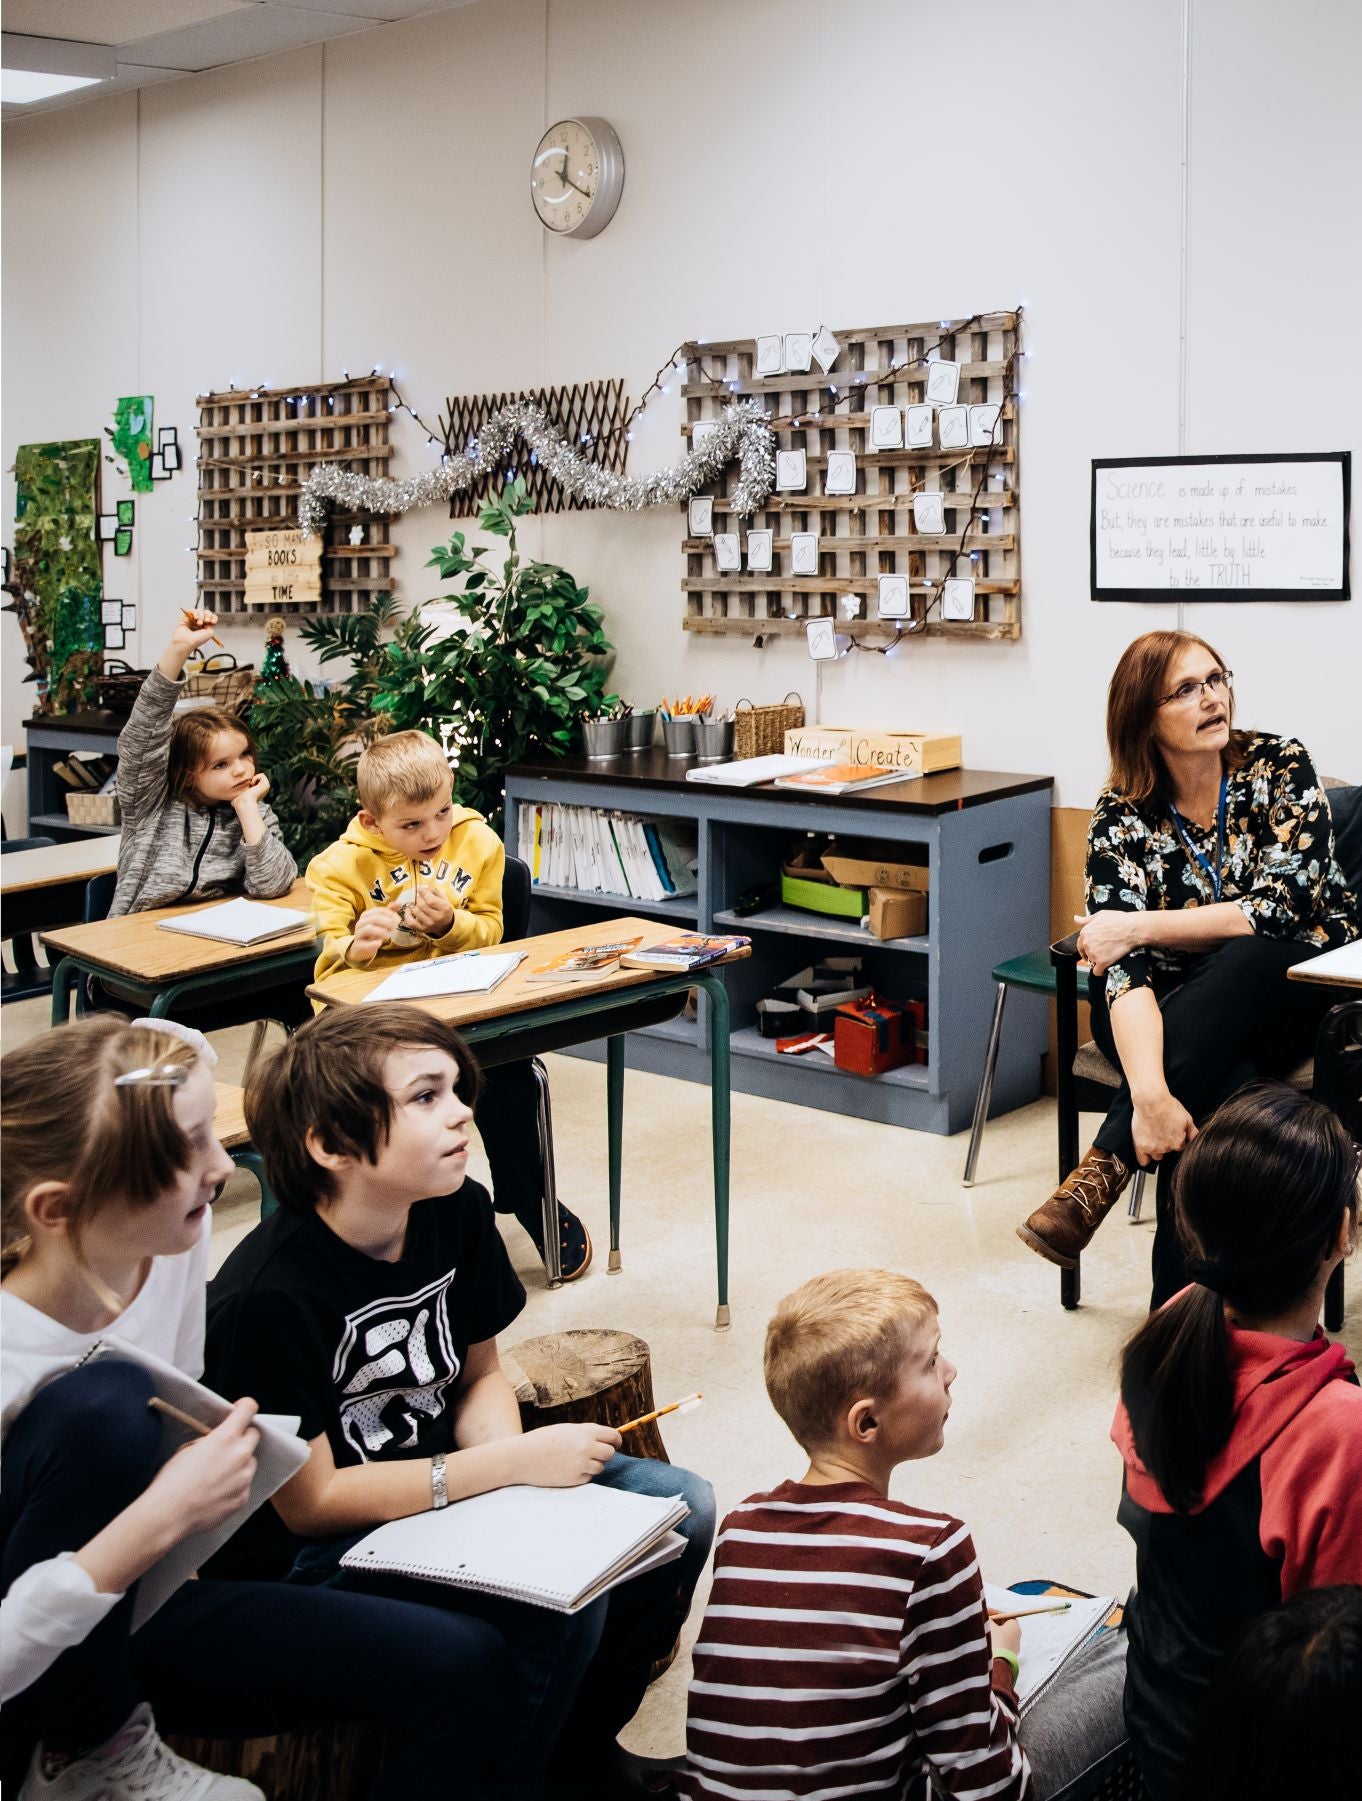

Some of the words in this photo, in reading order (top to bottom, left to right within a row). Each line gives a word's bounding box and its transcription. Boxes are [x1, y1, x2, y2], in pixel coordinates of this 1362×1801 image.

[584, 145, 589, 156] 2
[587, 164, 593, 175] 3
[577, 202, 582, 214] 5
[1107, 472, 1166, 500] Science
[1178, 487, 1187, 497] is
[1190, 480, 1215, 497] made
[1219, 487, 1229, 501] up
[1235, 478, 1245, 496] of
[1255, 480, 1297, 496] mistakes
[1101, 509, 1124, 531] But,
[1127, 509, 1147, 536] they
[1154, 517, 1169, 528] are
[1173, 509, 1214, 528] mistakes
[1219, 510, 1236, 527] that
[1240, 517, 1255, 527] are
[1259, 509, 1283, 528] useful
[1288, 512, 1297, 527] to
[1302, 509, 1328, 527] make
[265, 534, 279, 549] SO
[284, 533, 306, 548] MAN
[1109, 539, 1141, 559] because
[1146, 539, 1163, 565] they
[1195, 536, 1218, 558] little
[1224, 537, 1236, 565] by
[1242, 536, 1266, 558] little
[267, 549, 297, 566] BOOKS
[1169, 567, 1179, 588] to
[1185, 567, 1200, 587] the
[1208, 563, 1251, 586] TRUTH
[271, 584, 294, 600] TIME
[788, 736, 834, 760] Wonder
[855, 738, 915, 768] Create
